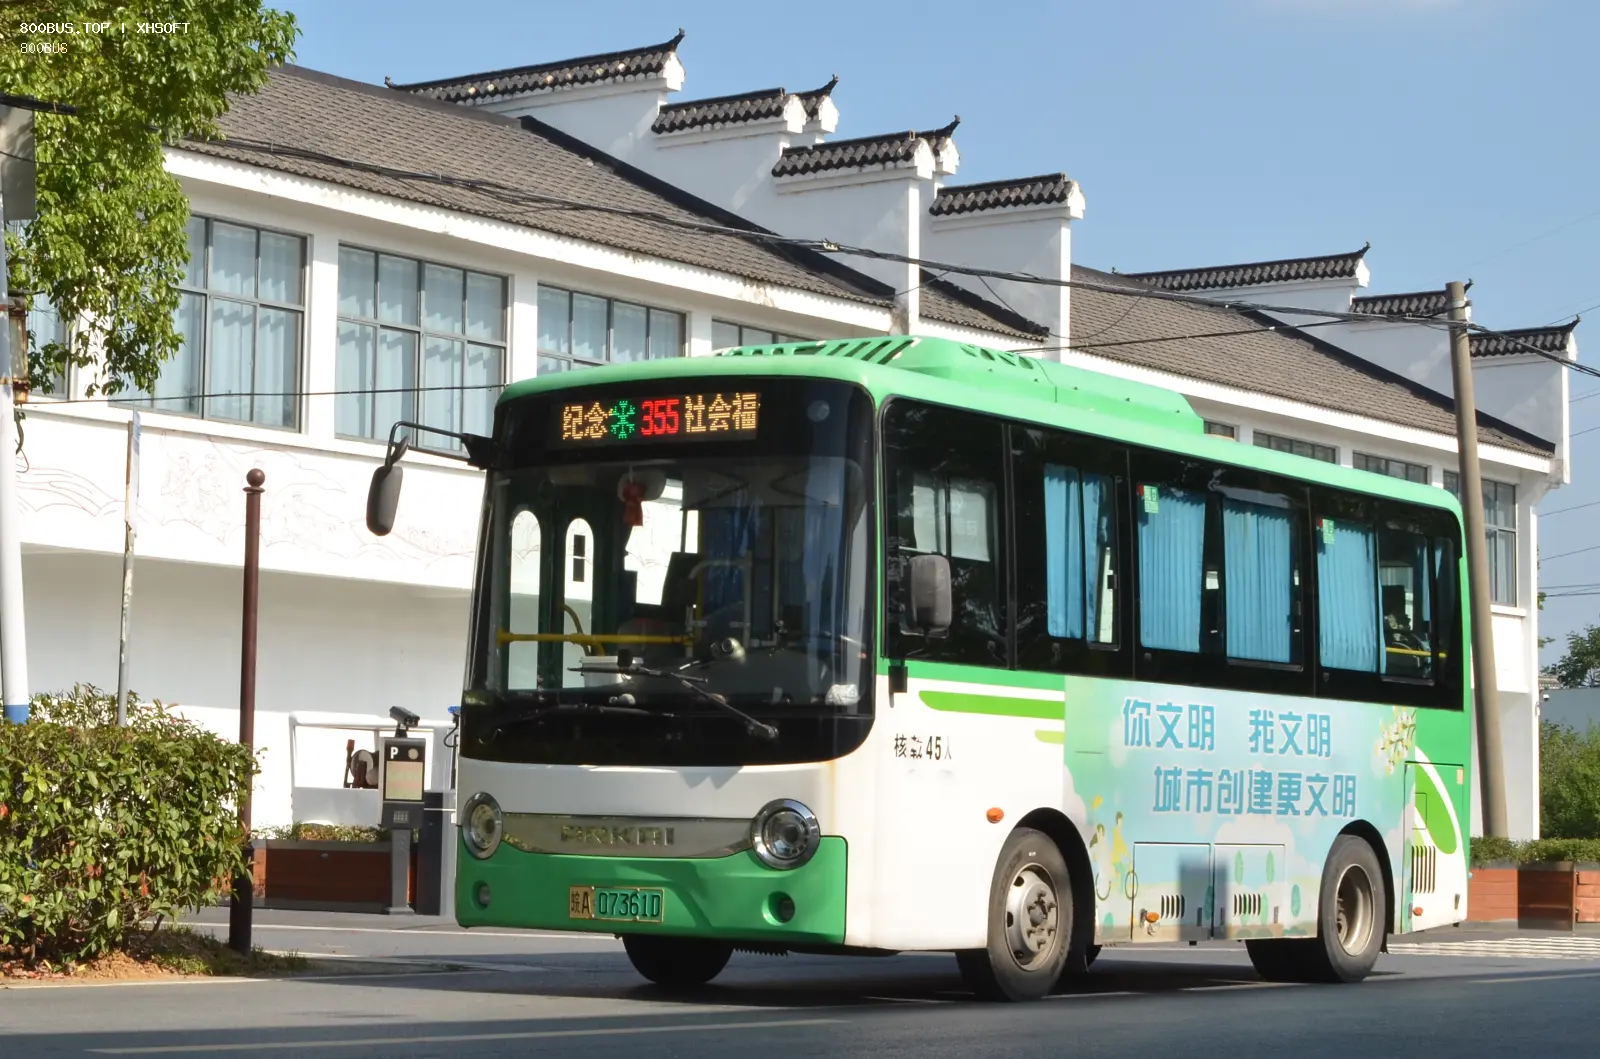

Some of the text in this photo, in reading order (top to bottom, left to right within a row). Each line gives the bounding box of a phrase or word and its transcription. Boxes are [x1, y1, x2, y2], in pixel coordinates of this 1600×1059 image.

[562, 392, 757, 440] 纪念 355 社会福
[390, 746, 399, 759] P
[1123, 698, 1332, 757] 你文明 我文明
[1153, 765, 1357, 818] 城市创建更文明
